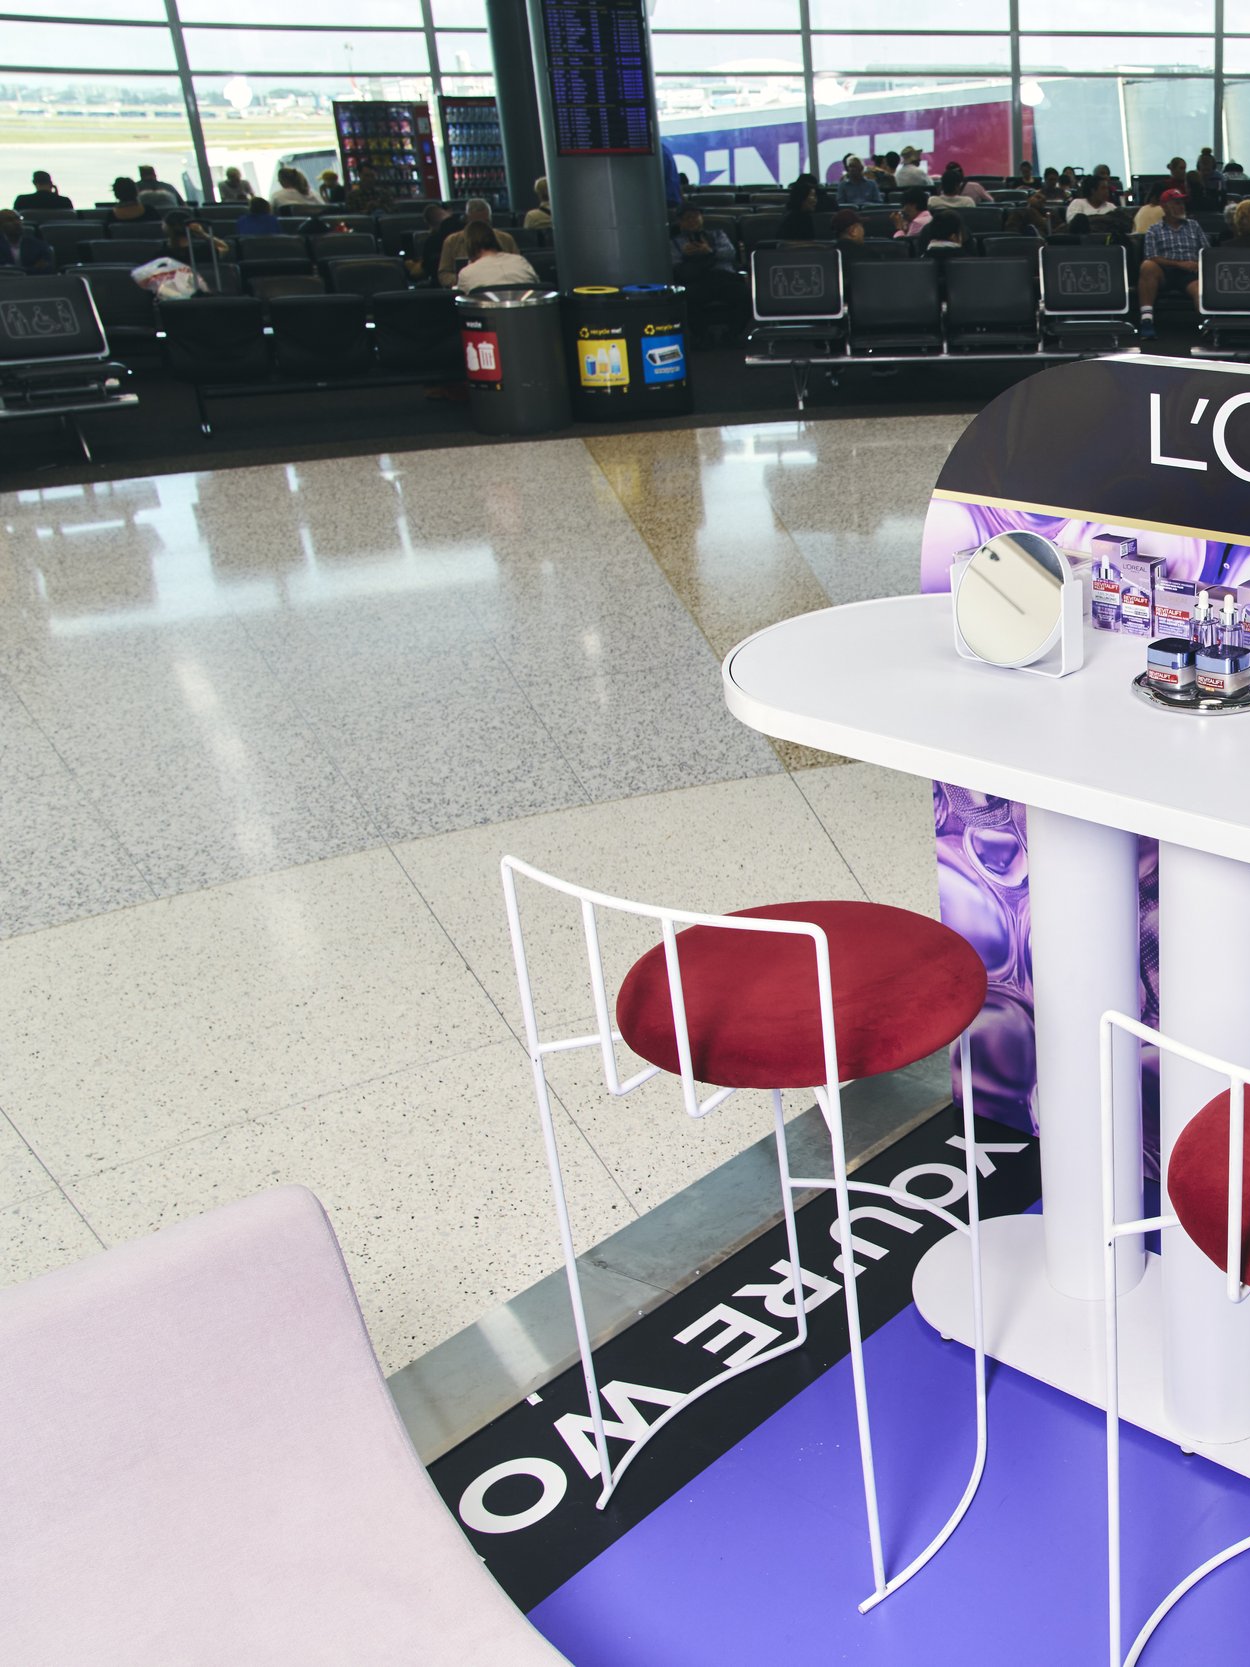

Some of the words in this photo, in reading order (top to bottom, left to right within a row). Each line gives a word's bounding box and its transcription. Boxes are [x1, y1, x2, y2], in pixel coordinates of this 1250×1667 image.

[1123, 594, 1148, 603] REVITALIFT
[1155, 606, 1182, 617] REVITALIFT
[1149, 670, 1171, 680] REVITALIFT
[1198, 675, 1224, 686] REVITALIFT
[673, 1134, 1030, 1369] YOU'RE
[458, 1380, 690, 1535] WO
